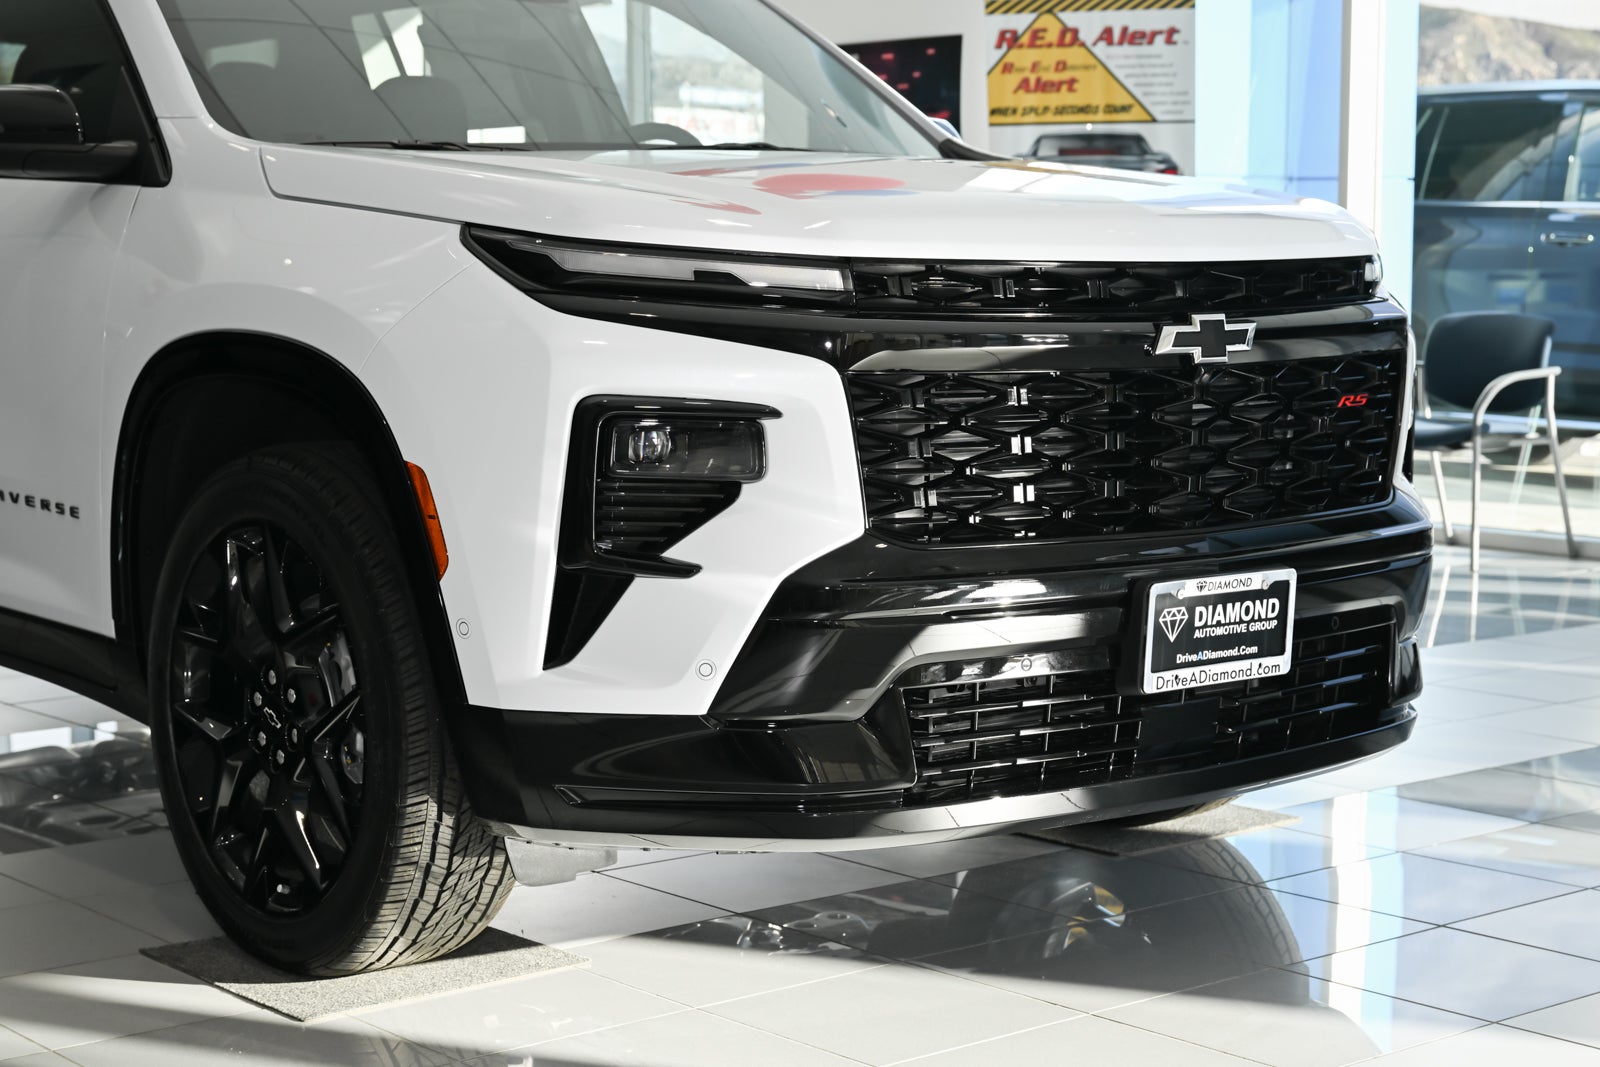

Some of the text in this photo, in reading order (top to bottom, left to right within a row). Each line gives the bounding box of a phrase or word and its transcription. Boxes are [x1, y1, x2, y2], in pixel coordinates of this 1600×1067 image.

[995, 26, 1180, 49] R.E.D. Alert
[1013, 76, 1079, 94] Alert
[990, 105, 1017, 117] WHEN
[1103, 102, 1134, 114] COUNT
[1337, 393, 1368, 408] RS
[1207, 577, 1252, 592] DIAMOND
[1194, 598, 1280, 627] DIAMOND
[1193, 619, 1278, 639] AUTOMOTIVE GROUP
[1176, 645, 1258, 663] DriveADiamond.Com
[1156, 662, 1281, 690] DriveADiamond.com
